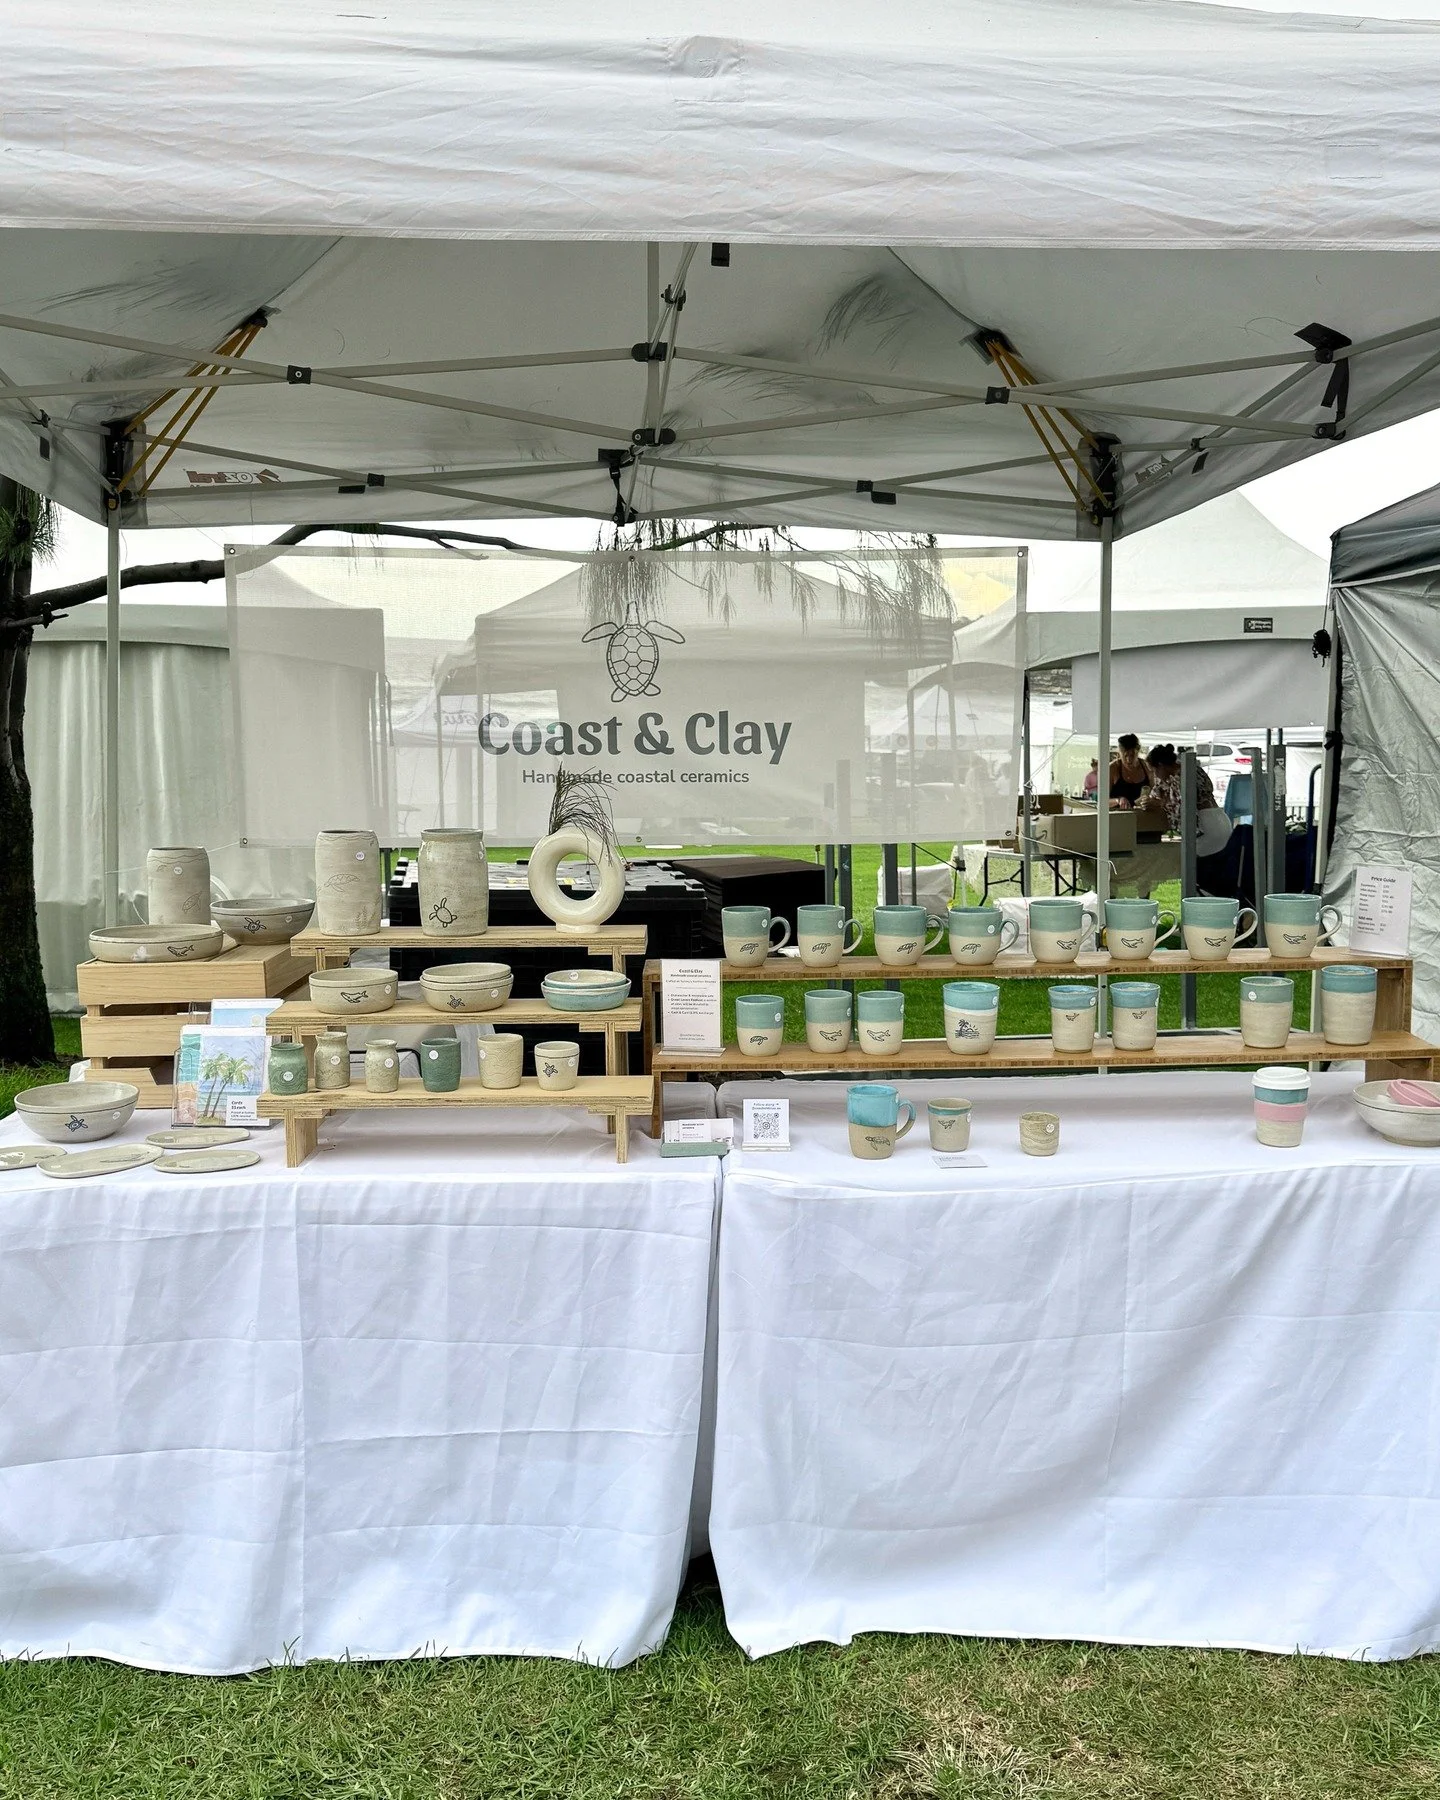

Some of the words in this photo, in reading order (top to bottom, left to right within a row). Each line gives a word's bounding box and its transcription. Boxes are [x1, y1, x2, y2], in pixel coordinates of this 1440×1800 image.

[478, 712, 622, 756] Coast
[633, 711, 675, 756] &
[685, 710, 792, 765] Clay
[523, 769, 612, 784] Handmade
[617, 769, 675, 783] coastal
[680, 769, 749, 783] ceramics
